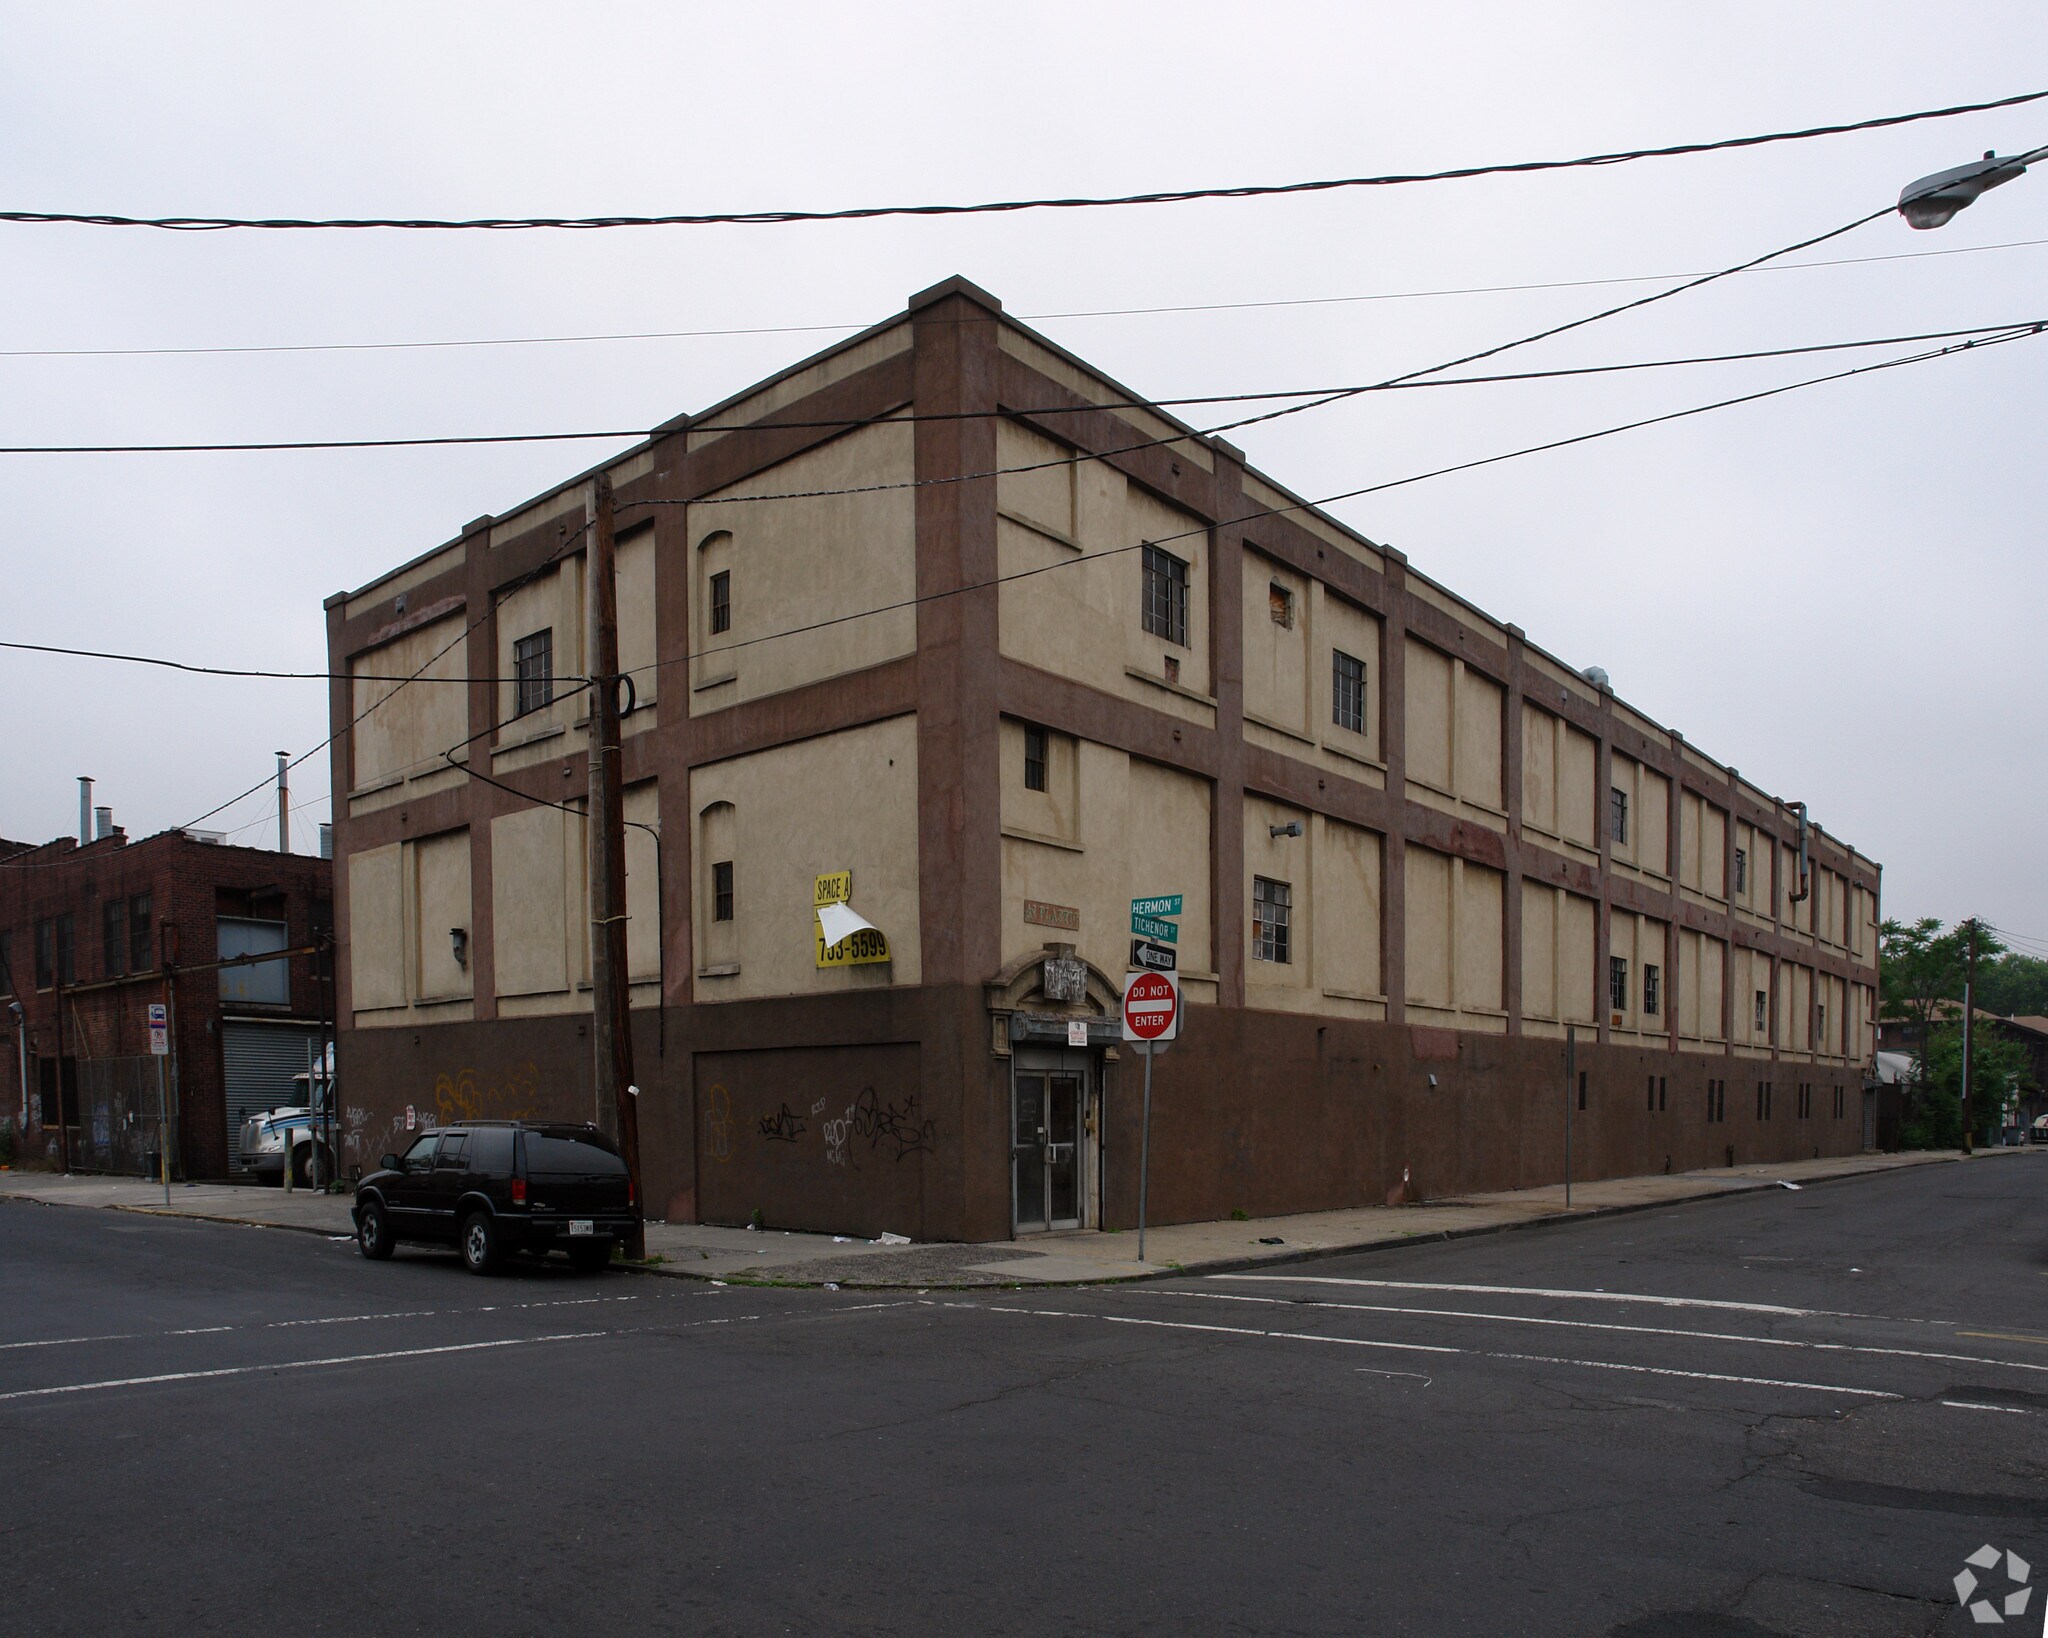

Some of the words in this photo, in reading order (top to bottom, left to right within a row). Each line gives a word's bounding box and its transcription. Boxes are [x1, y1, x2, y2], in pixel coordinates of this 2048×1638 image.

[818, 877, 841, 901] SPACE
[1132, 899, 1171, 914] HERMON
[1174, 898, 1181, 906] ST
[1134, 916, 1169, 938] TICHENOR
[1146, 950, 1158, 963] ONE
[1160, 954, 1172, 966] WAY
[1133, 986, 1145, 998] DO
[1150, 985, 1169, 997] NOT
[1135, 1015, 1164, 1027] ENTER
